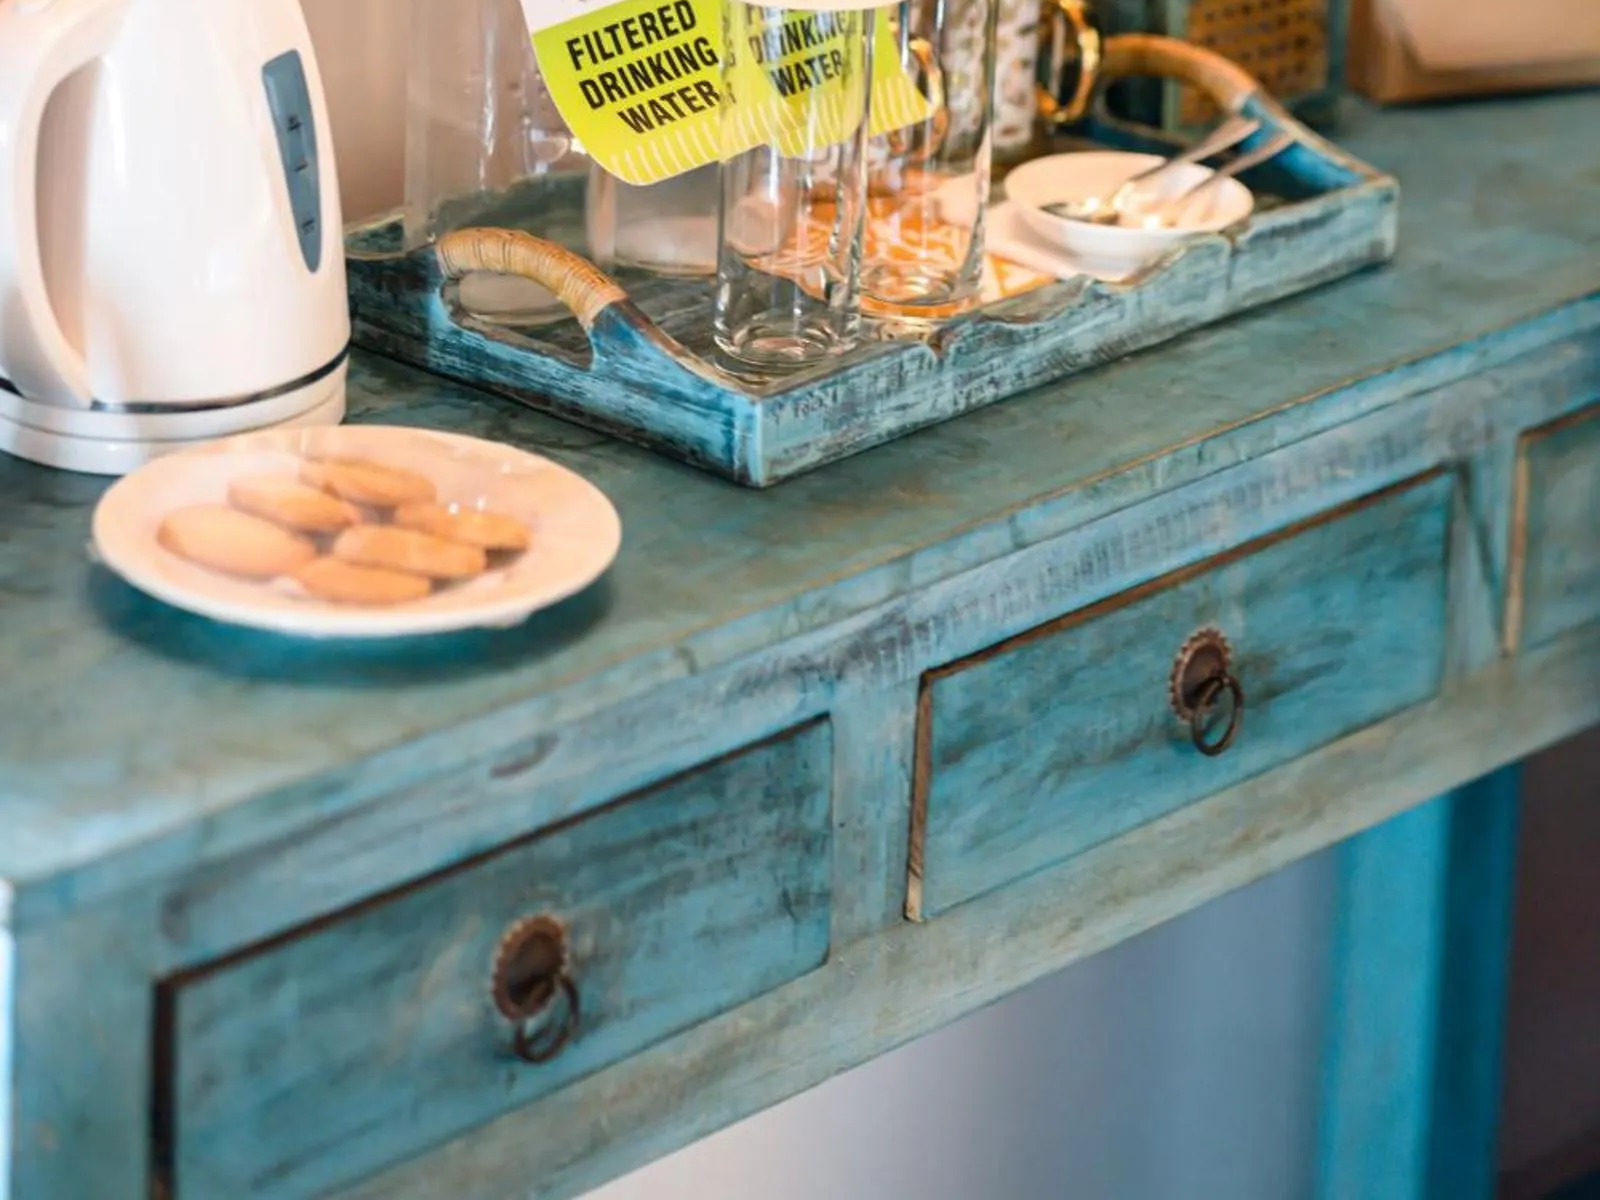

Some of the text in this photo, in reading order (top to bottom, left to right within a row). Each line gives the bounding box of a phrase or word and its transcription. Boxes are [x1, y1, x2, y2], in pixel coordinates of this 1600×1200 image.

[566, 0, 696, 71] FILTERED
[579, 36, 719, 110] DRINKING
[770, 49, 842, 97] WATER
[617, 80, 721, 134] WATER
